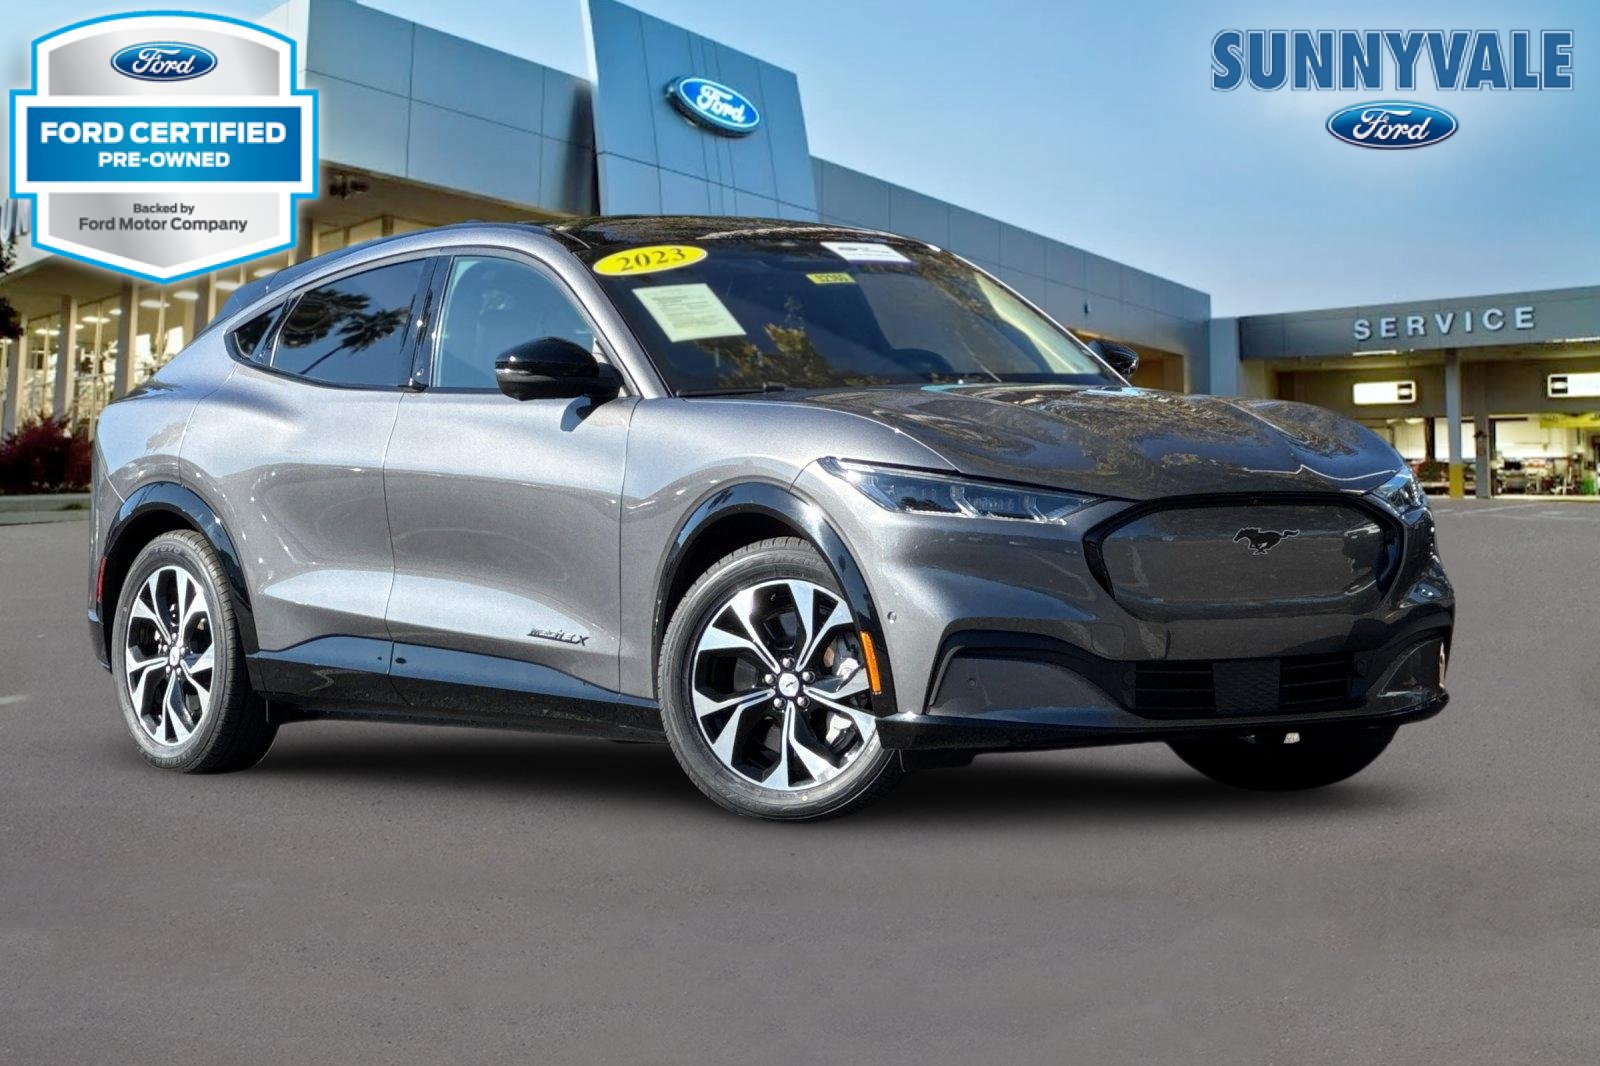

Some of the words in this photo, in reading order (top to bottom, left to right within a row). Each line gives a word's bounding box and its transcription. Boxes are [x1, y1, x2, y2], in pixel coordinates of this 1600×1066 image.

[696, 84, 747, 122] Ford
[616, 247, 686, 271] 2023
[1353, 306, 1536, 341] SERVICE
